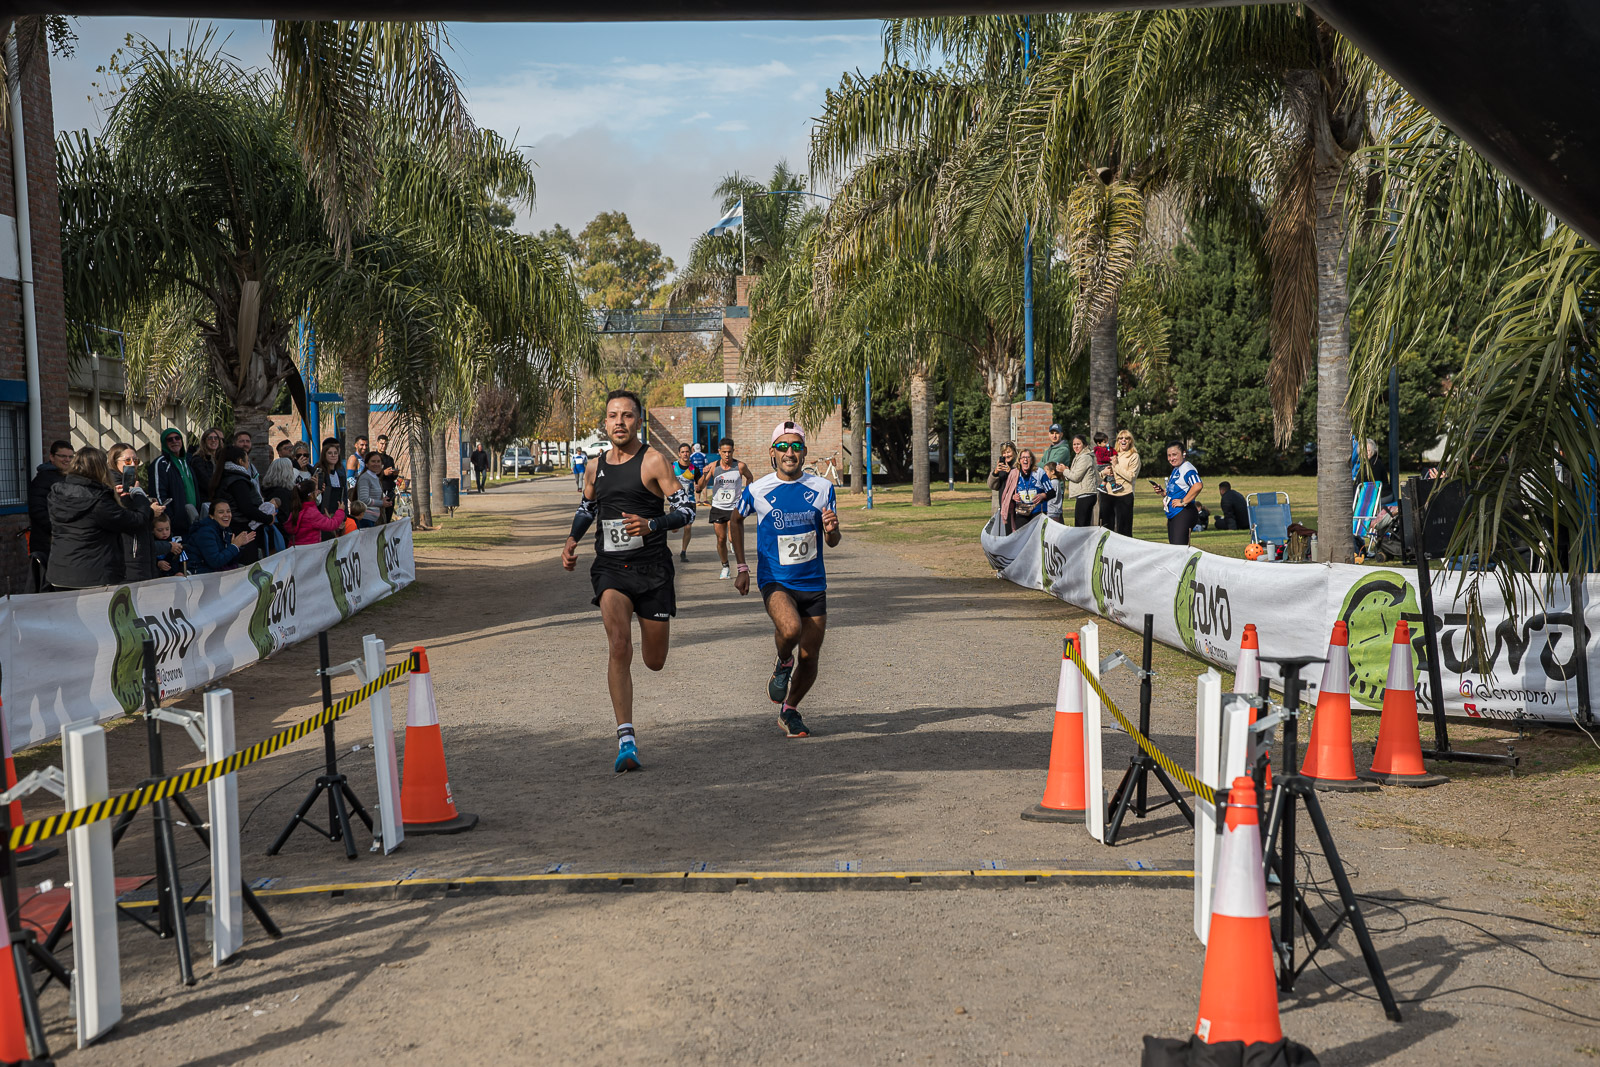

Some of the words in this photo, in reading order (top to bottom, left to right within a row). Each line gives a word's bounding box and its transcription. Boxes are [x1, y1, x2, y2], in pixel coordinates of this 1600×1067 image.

[721, 492, 731, 500] 70
[771, 508, 785, 530] 3
[610, 527, 631, 543] 88
[787, 541, 809, 558] 20
[1475, 683, 1557, 705] @cronorav
